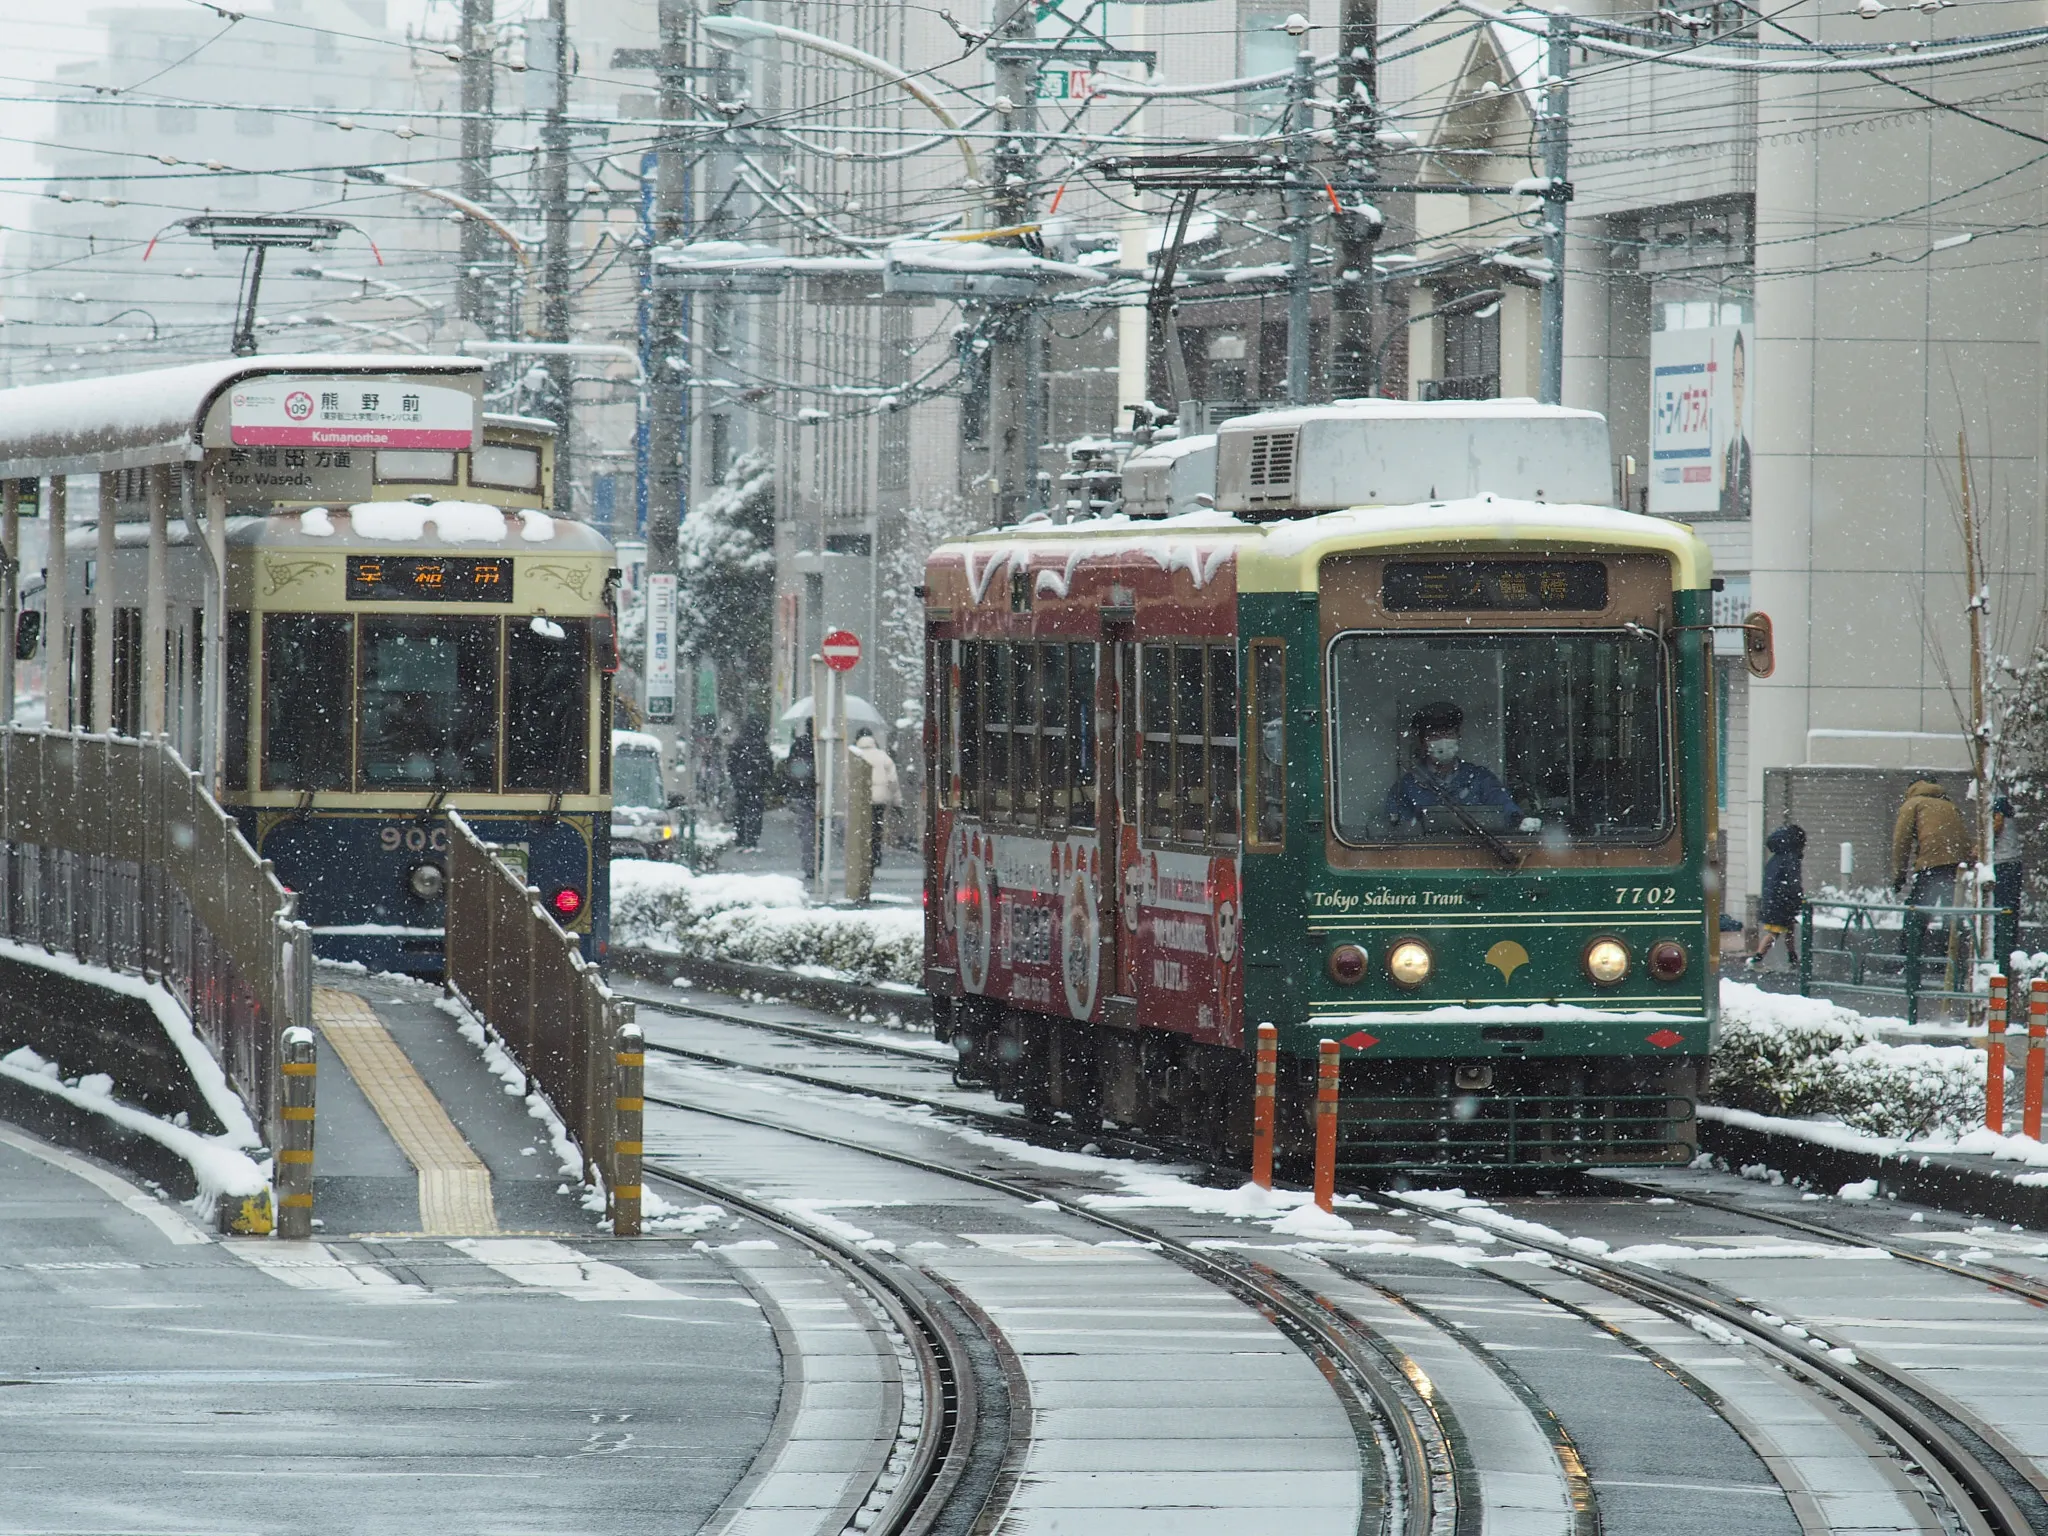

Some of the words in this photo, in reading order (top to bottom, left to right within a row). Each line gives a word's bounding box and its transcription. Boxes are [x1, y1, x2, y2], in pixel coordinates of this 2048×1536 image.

[291, 404, 307, 415] 09
[321, 392, 420, 412] 熊野前
[1658, 385, 1708, 434] トライプラス
[312, 431, 389, 443] Kumanomae
[228, 472, 250, 484] for
[254, 473, 312, 486] Waseda
[1313, 890, 1359, 913] Tokyo
[1363, 889, 1416, 906] Sakura
[1422, 891, 1463, 905] Tram
[1615, 887, 1677, 904] 7702
